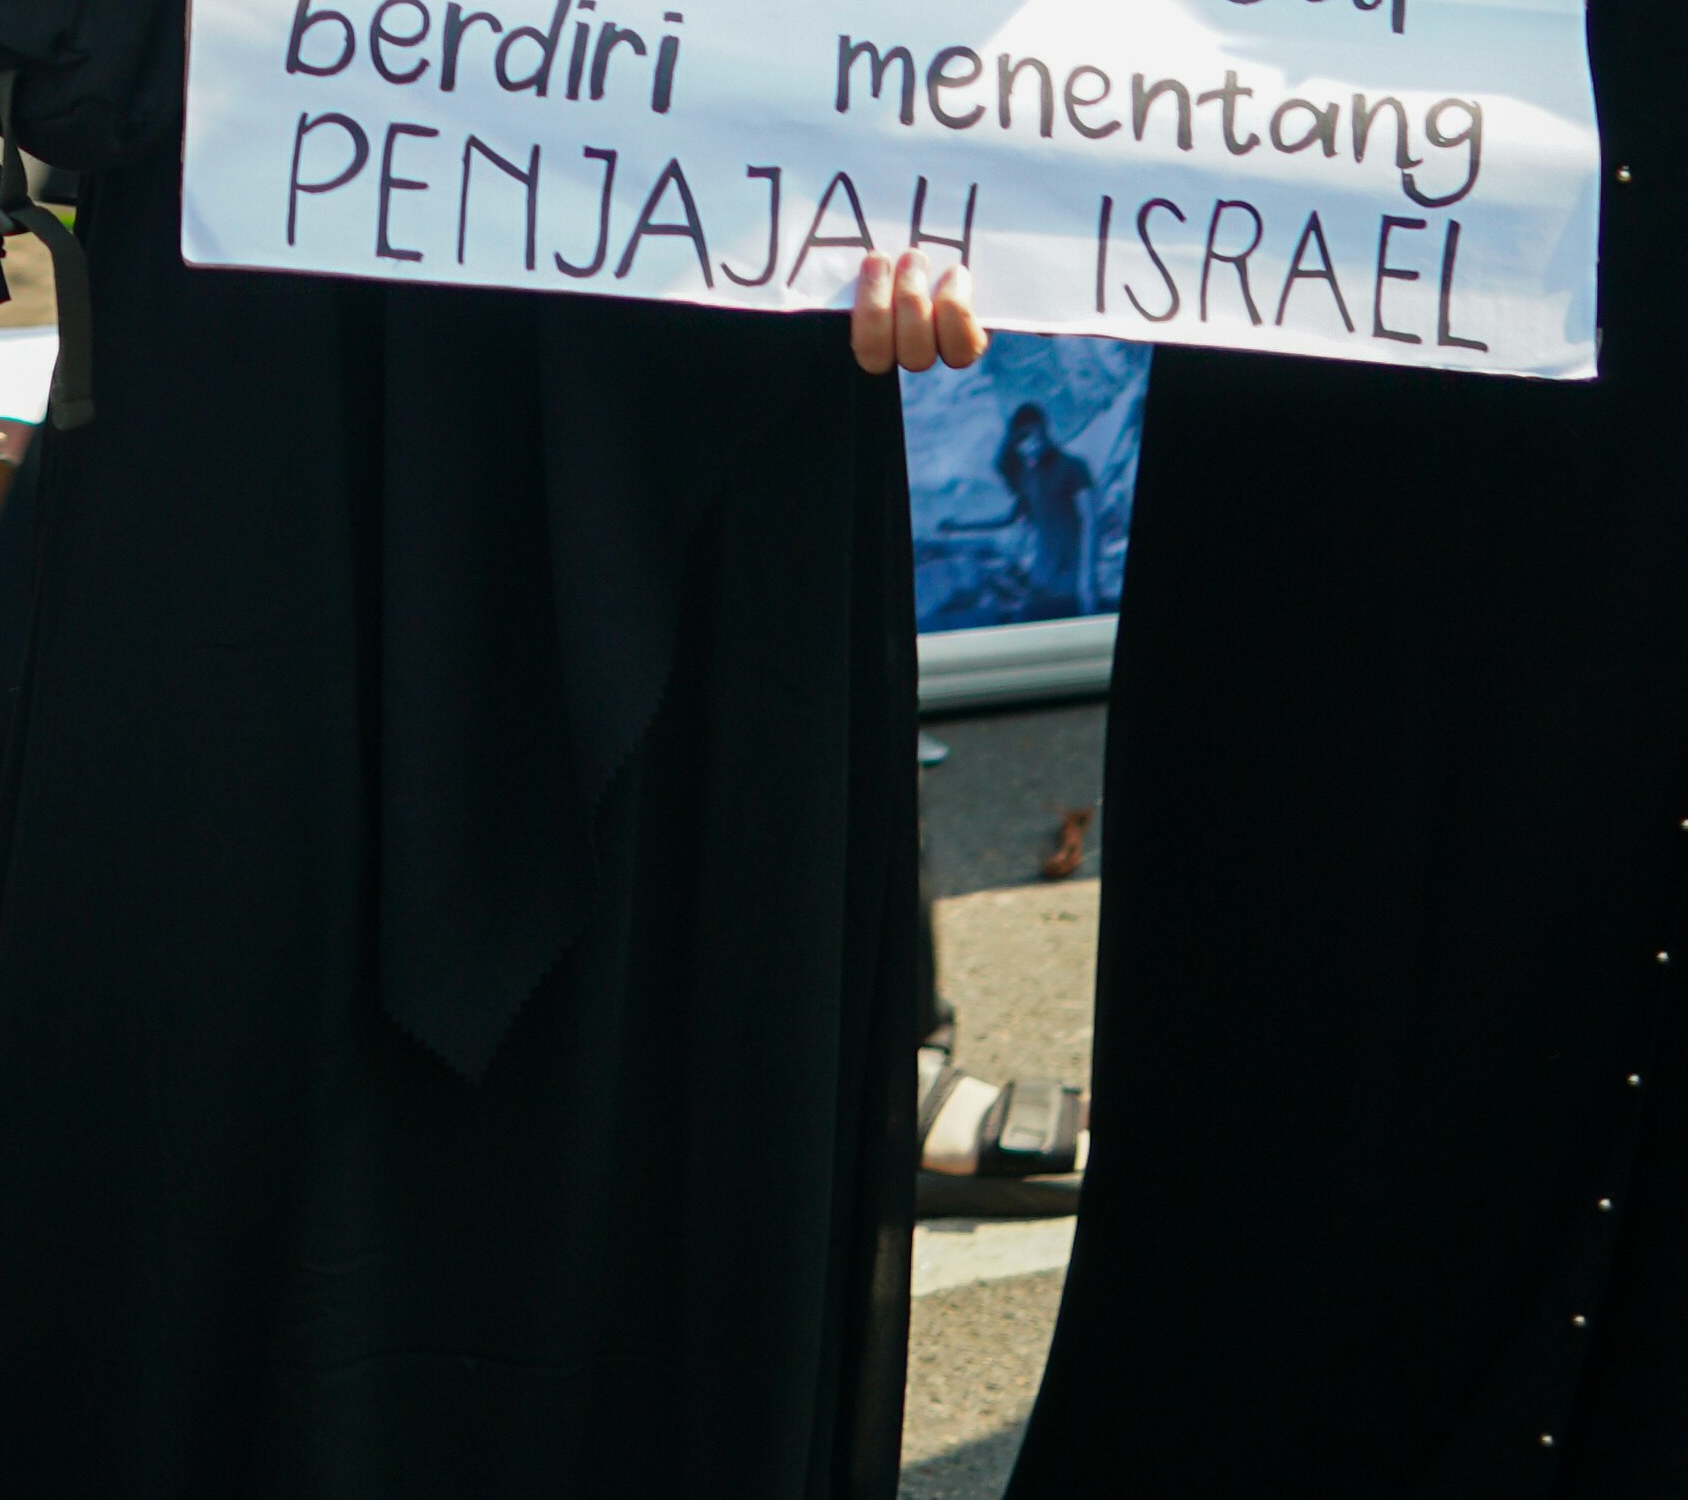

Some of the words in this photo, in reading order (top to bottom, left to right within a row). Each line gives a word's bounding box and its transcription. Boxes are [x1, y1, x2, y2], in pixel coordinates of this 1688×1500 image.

[836, 32, 1484, 207] menentang
[288, 112, 980, 289] PENJAJAH
[1095, 194, 1488, 352] ISRAEL
